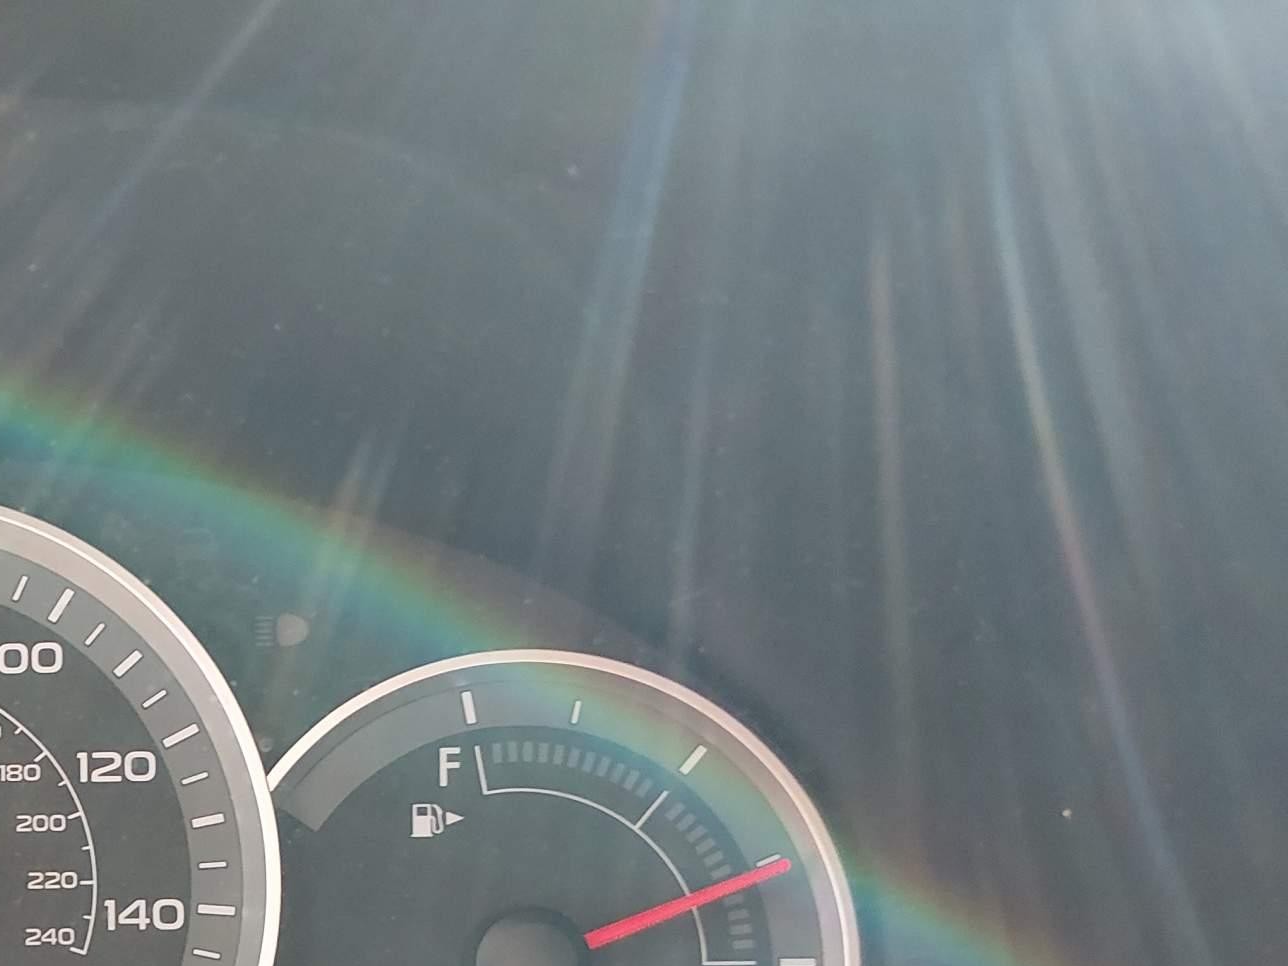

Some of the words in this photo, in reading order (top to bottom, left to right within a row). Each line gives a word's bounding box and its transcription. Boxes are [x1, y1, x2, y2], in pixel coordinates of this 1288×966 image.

[0, 764, 40, 781] 180
[77, 751, 156, 782] 120
[440, 747, 461, 786] F
[16, 815, 66, 832] 200
[28, 872, 77, 889] 220
[104, 899, 184, 930] 140
[25, 928, 74, 945] 240
